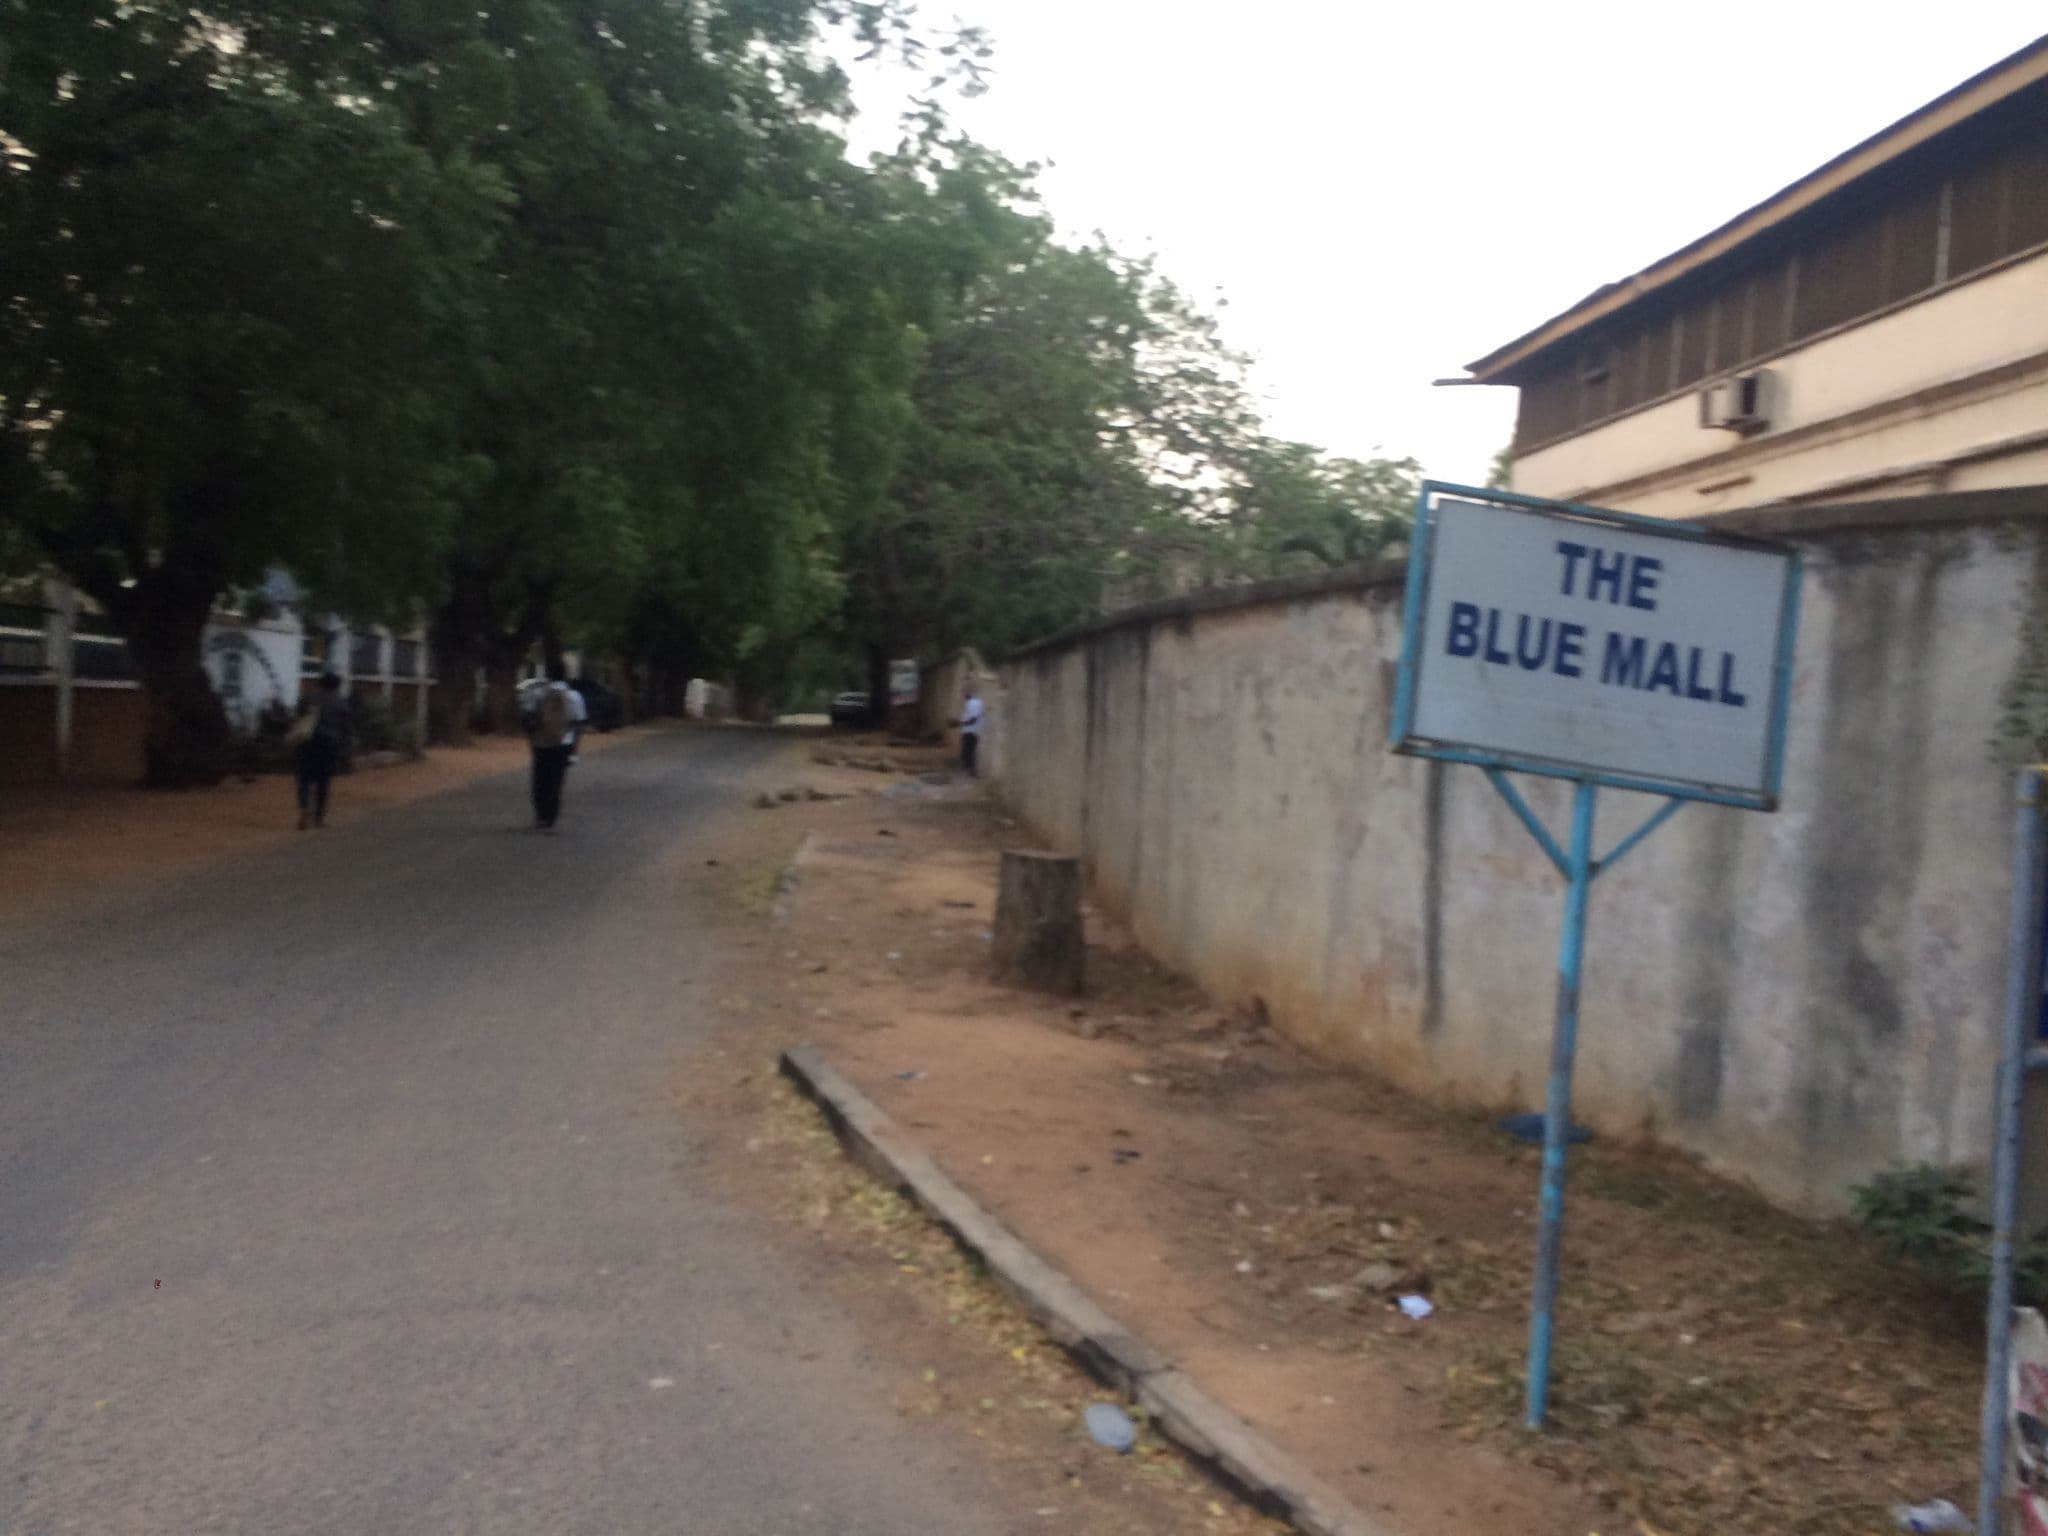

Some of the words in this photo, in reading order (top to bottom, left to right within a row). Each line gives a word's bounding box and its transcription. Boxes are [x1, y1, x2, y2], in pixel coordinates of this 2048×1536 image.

[1556, 541, 1663, 611] THE
[1445, 601, 1587, 678] BLUE
[1601, 631, 1747, 707] MALL
